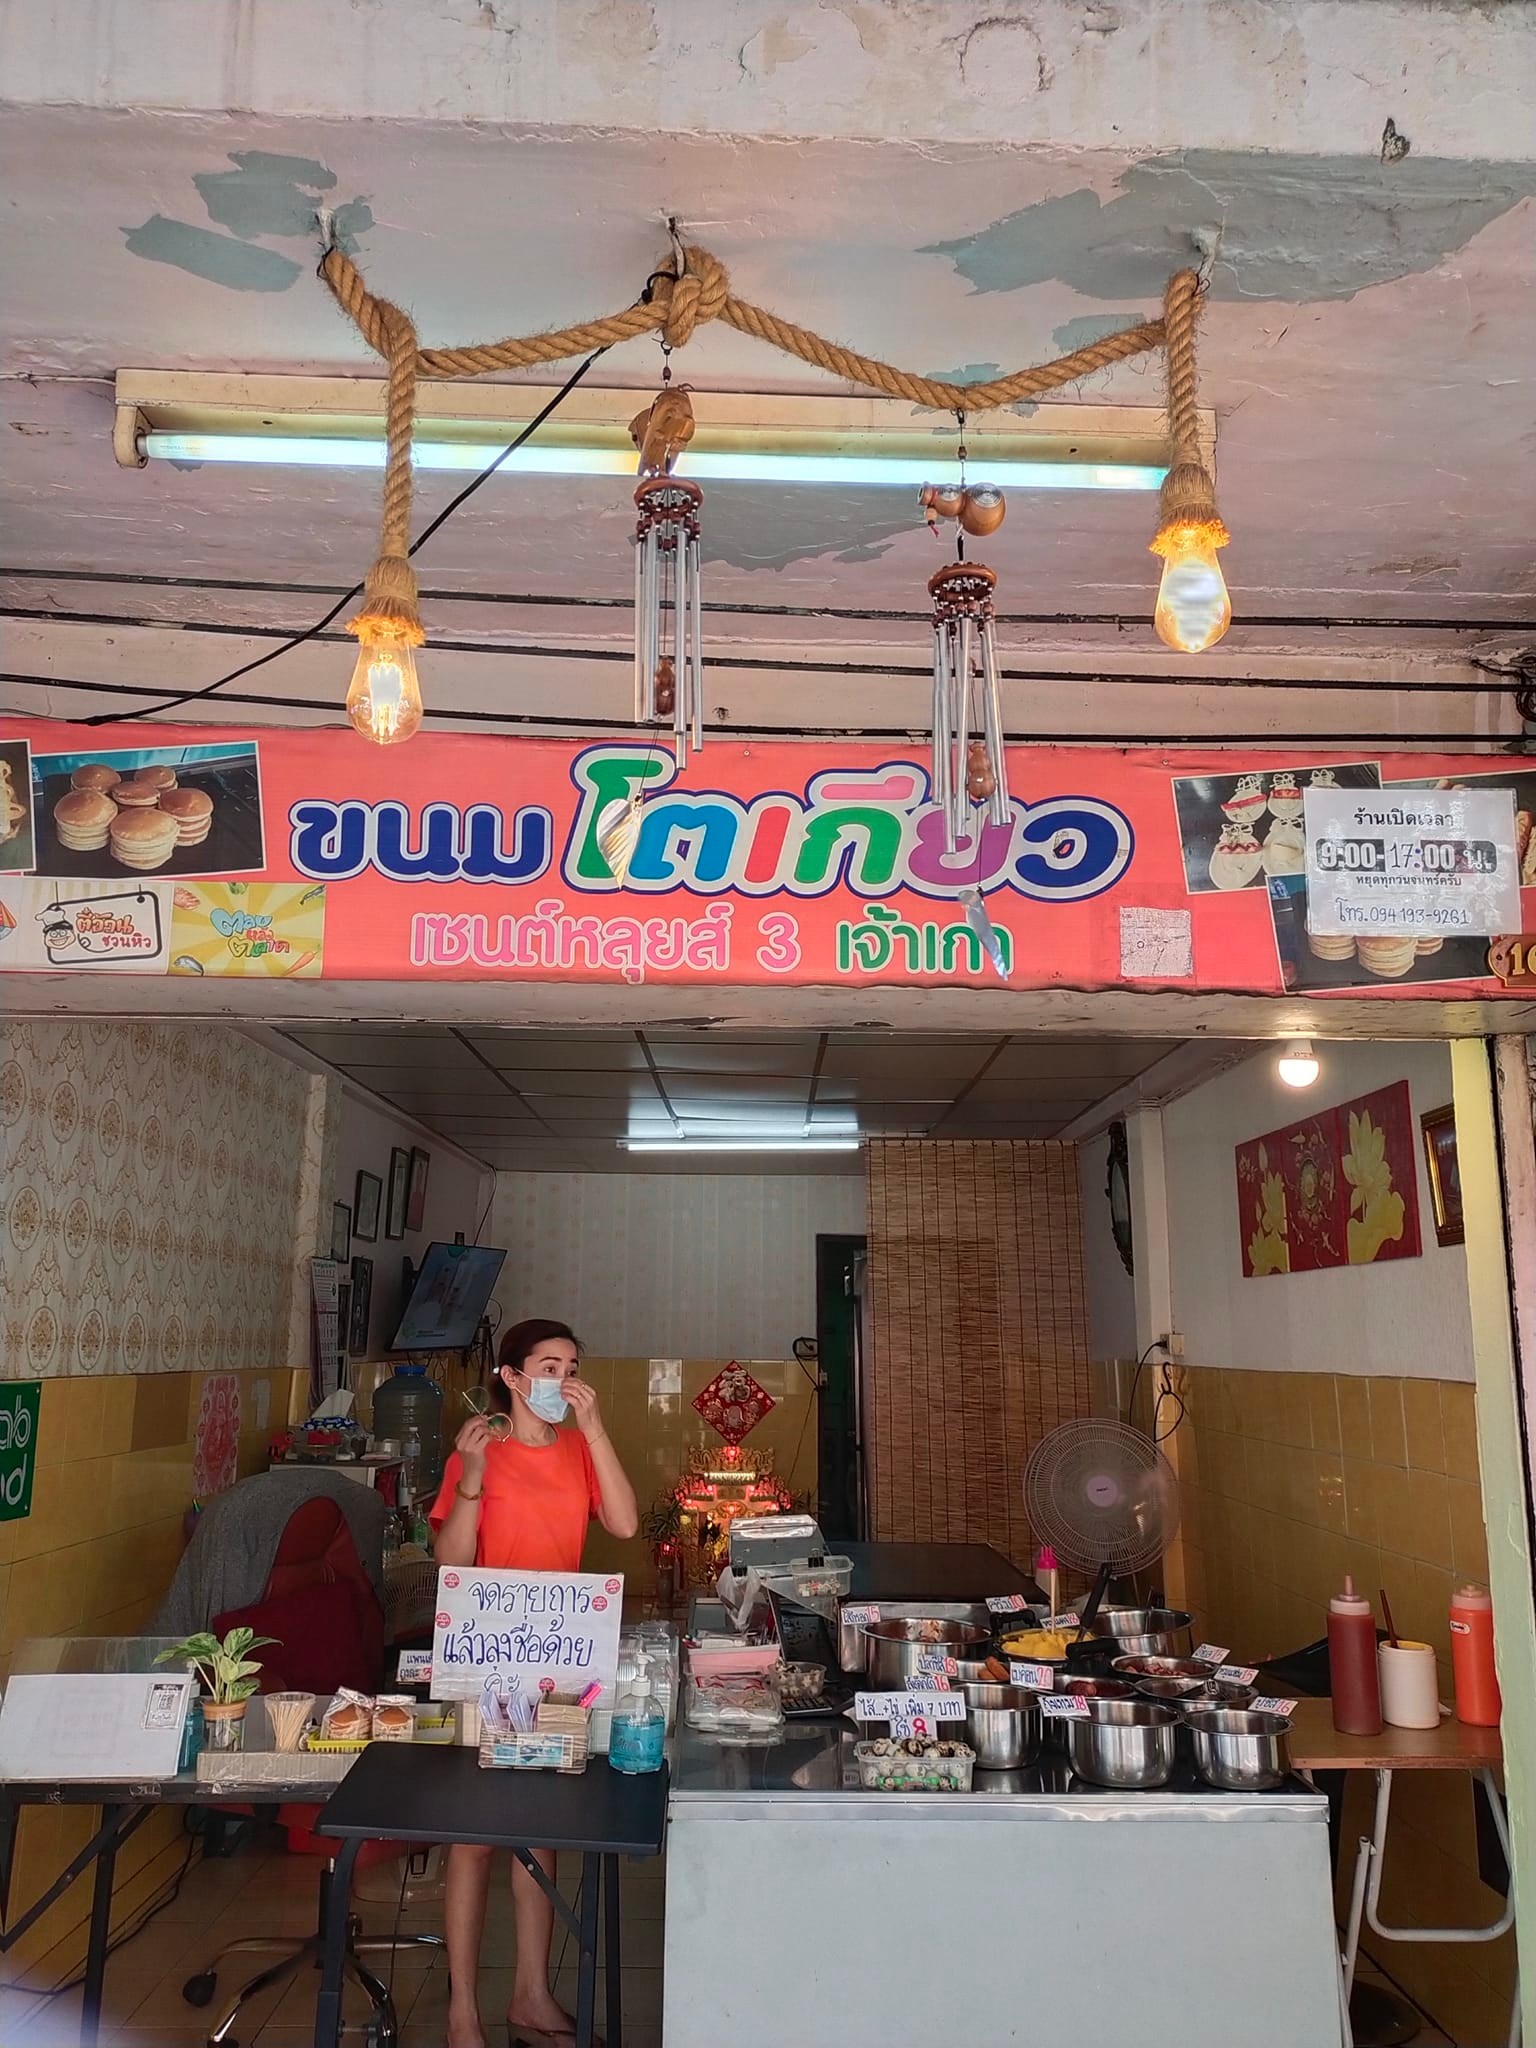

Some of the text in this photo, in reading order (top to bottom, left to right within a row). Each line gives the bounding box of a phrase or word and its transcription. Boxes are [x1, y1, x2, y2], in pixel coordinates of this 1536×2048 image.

[1354, 808, 1454, 827] ร้านเปิดเวลา
[410, 899, 734, 984] เซนต์หลุยส์
[757, 911, 800, 972] 3
[443, 1614, 594, 1667] แล้วลงชื่อด้วย
[484, 1665, 520, 1698] ค่ะ
[905, 1694, 924, 1716] เพิ่ม
[939, 1700, 961, 1716] บาท
